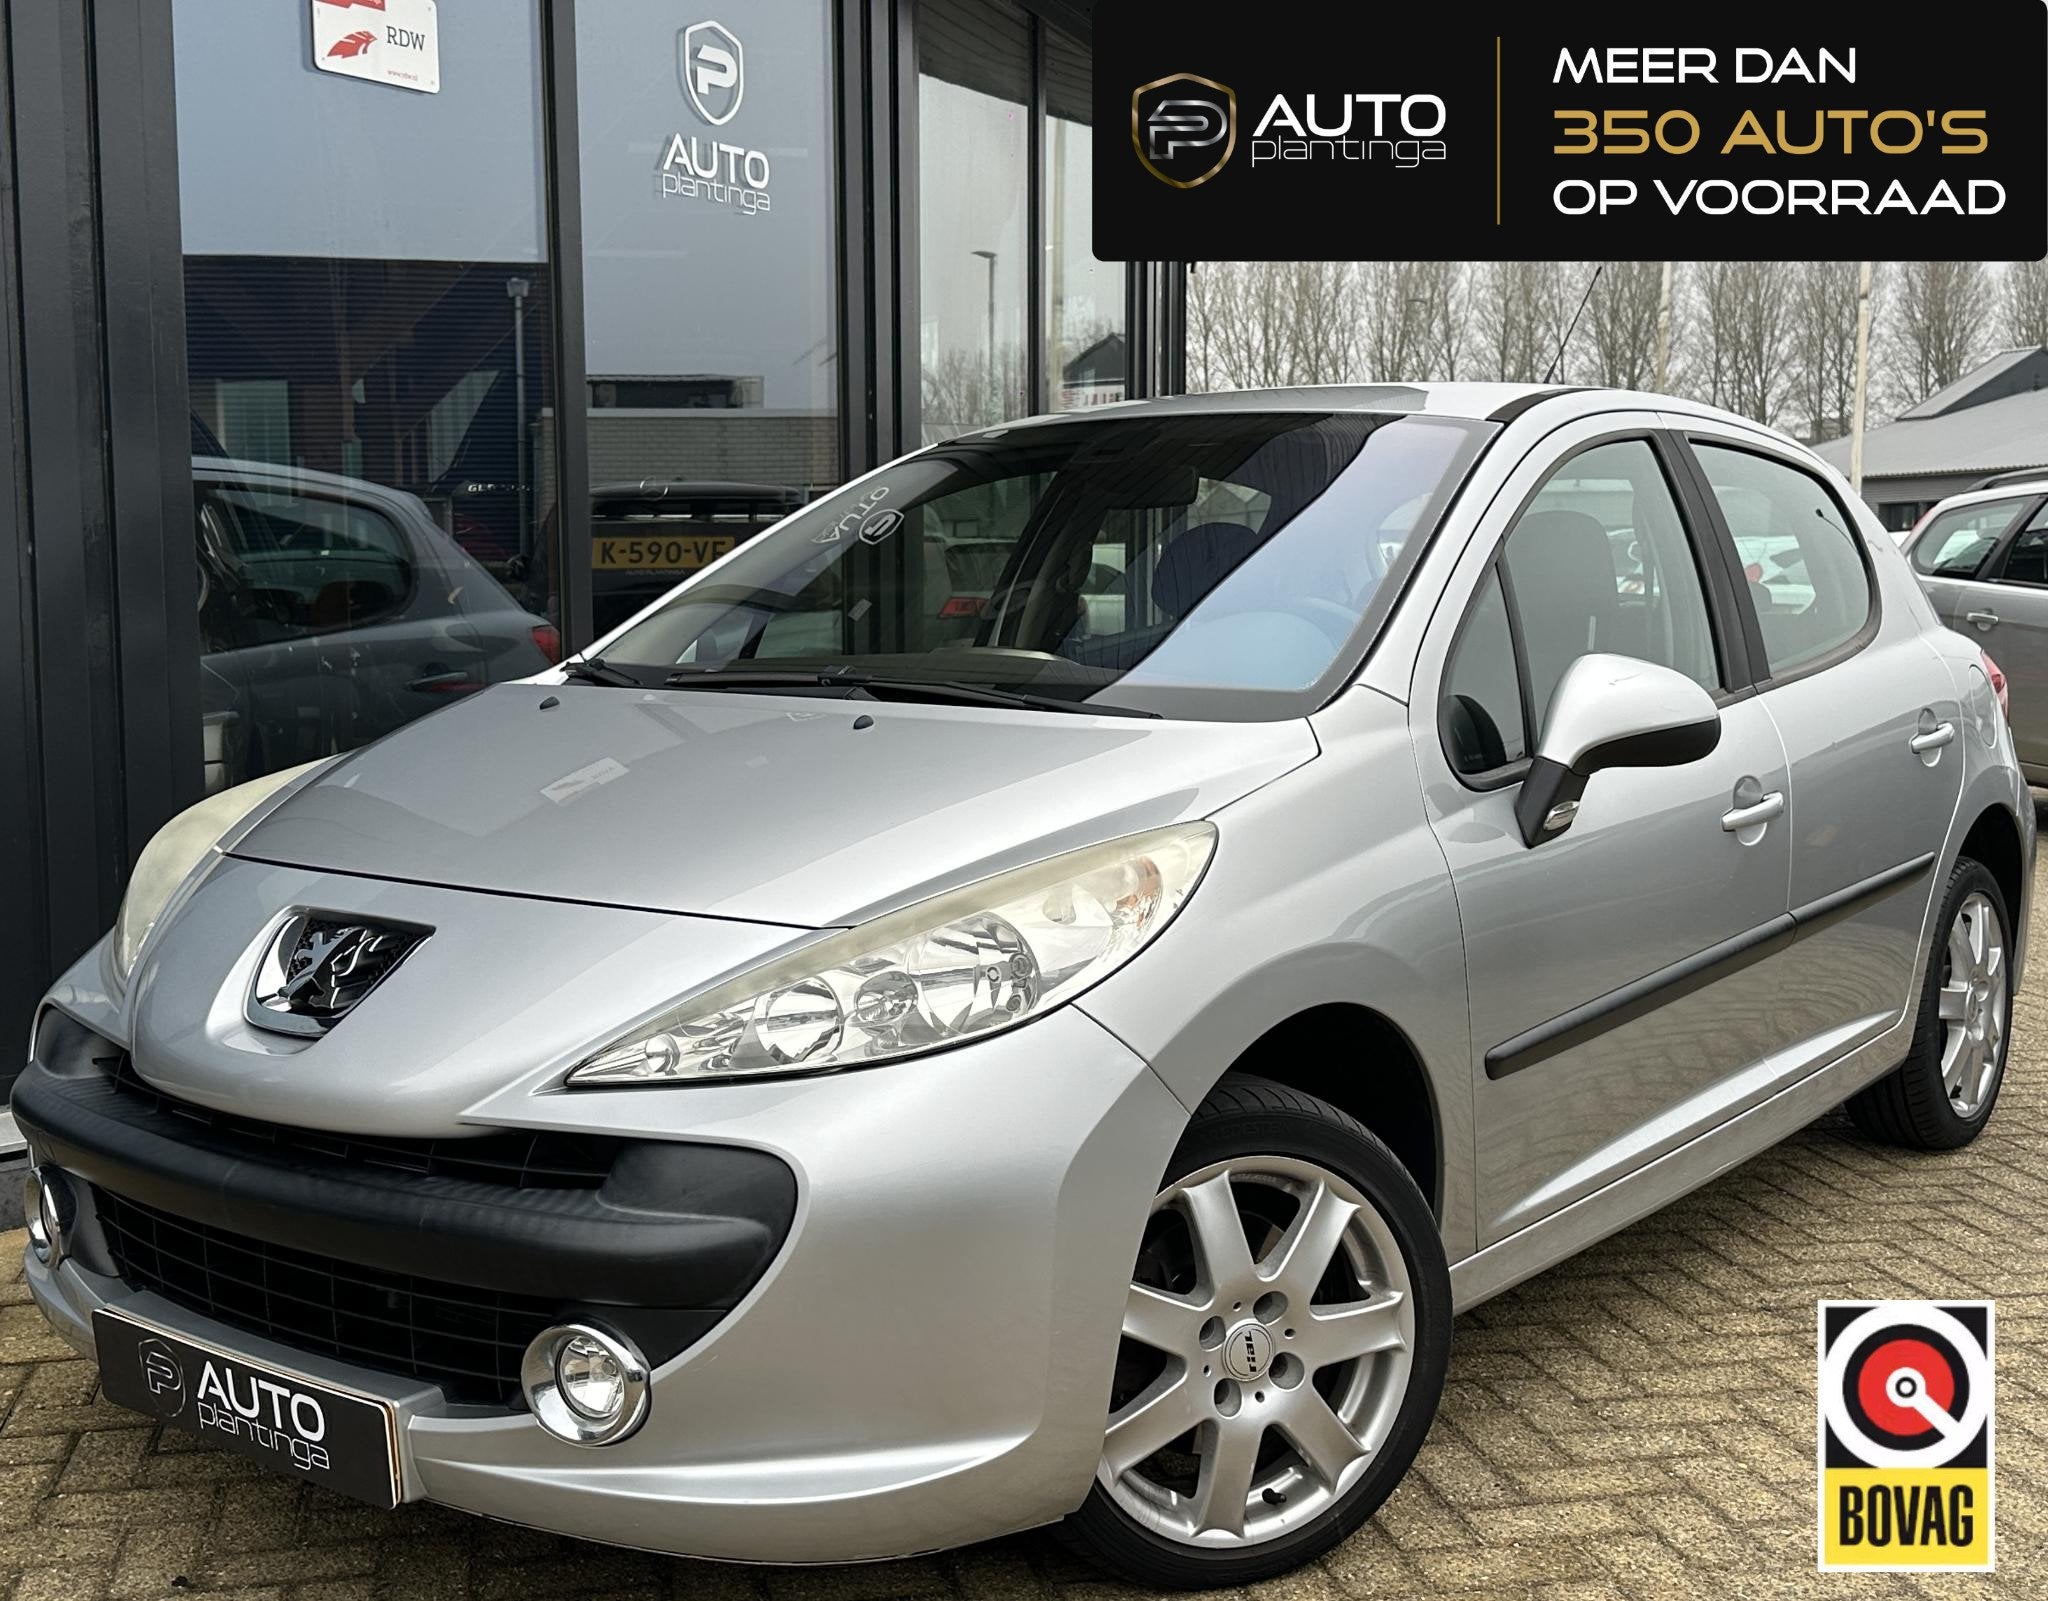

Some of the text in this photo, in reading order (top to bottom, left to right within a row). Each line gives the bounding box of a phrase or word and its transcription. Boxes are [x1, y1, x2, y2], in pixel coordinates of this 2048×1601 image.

[387, 26, 425, 51] RDW
[663, 133, 769, 189] AUTO
[663, 171, 770, 215] plantinga
[198, 1360, 325, 1442] AUTO
[198, 1402, 330, 1470] plantinga
